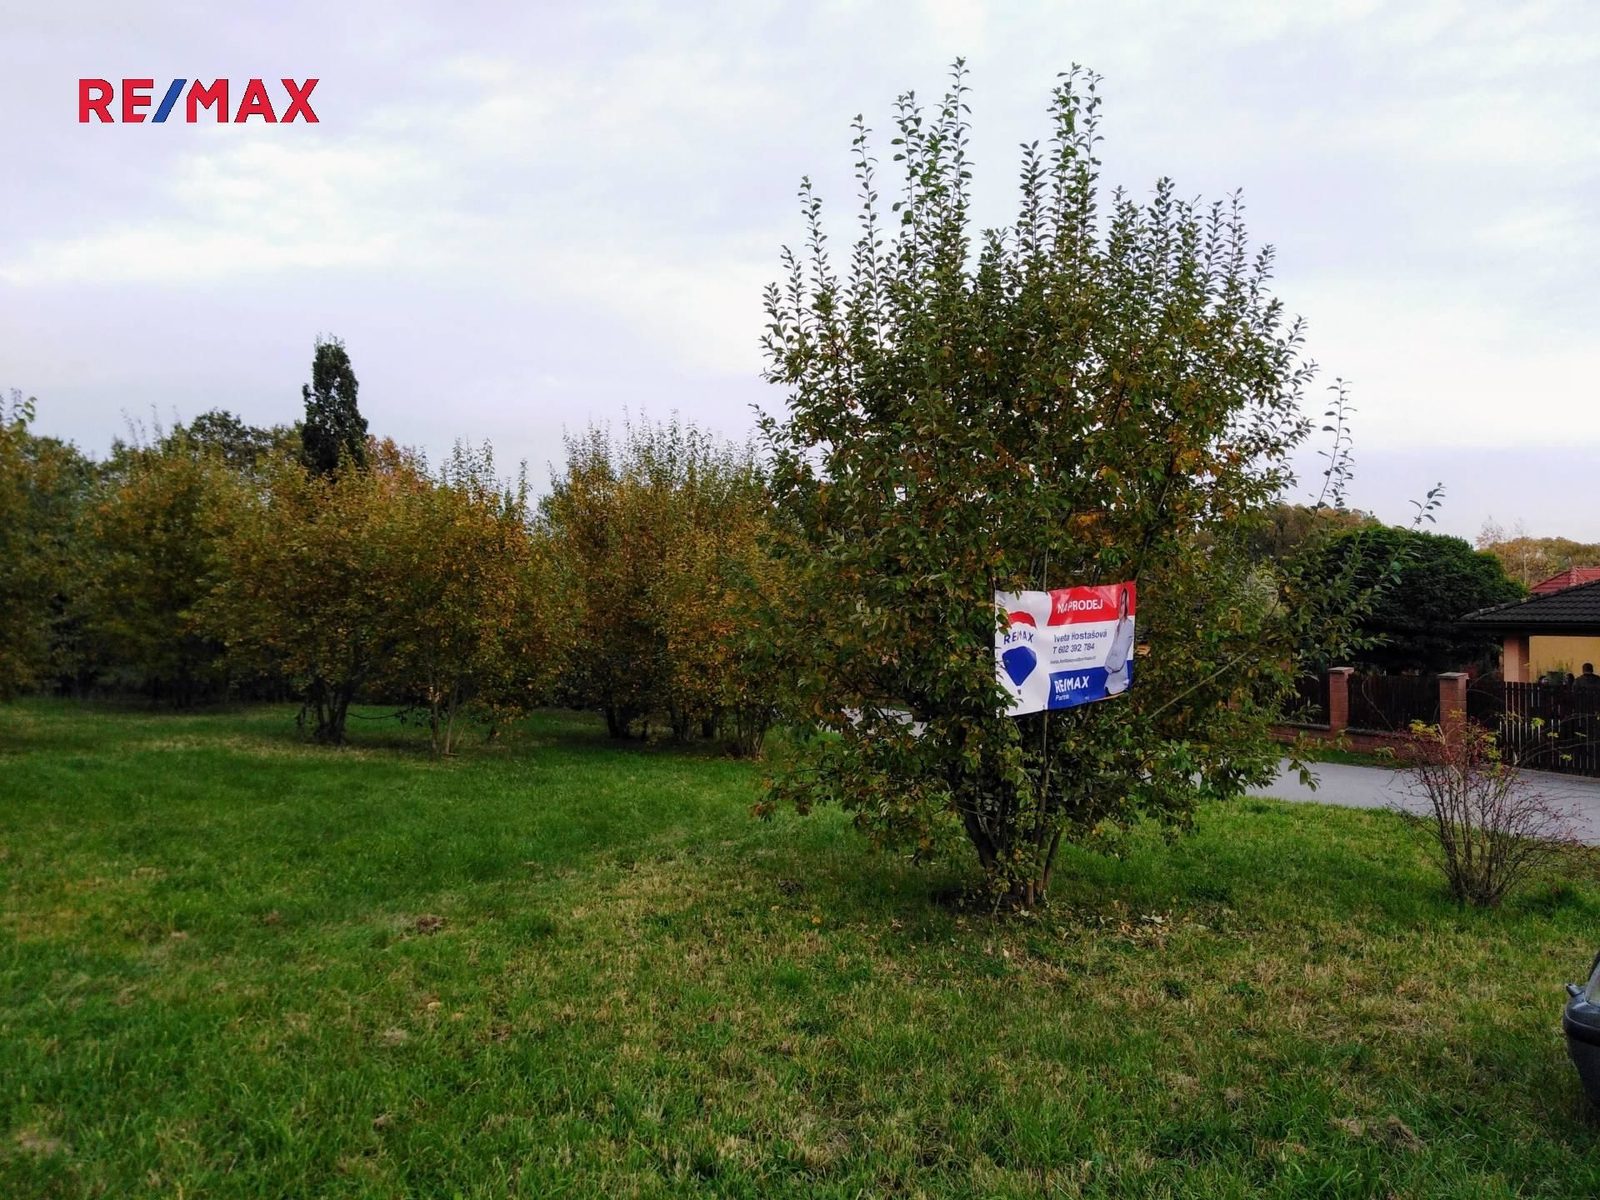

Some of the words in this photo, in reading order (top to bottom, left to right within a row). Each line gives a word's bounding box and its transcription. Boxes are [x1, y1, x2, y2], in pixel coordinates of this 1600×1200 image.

[1067, 599, 1103, 611] PRODEJ
[1054, 633, 1070, 643] Iveta
[1054, 675, 1090, 694] RE/MAX
